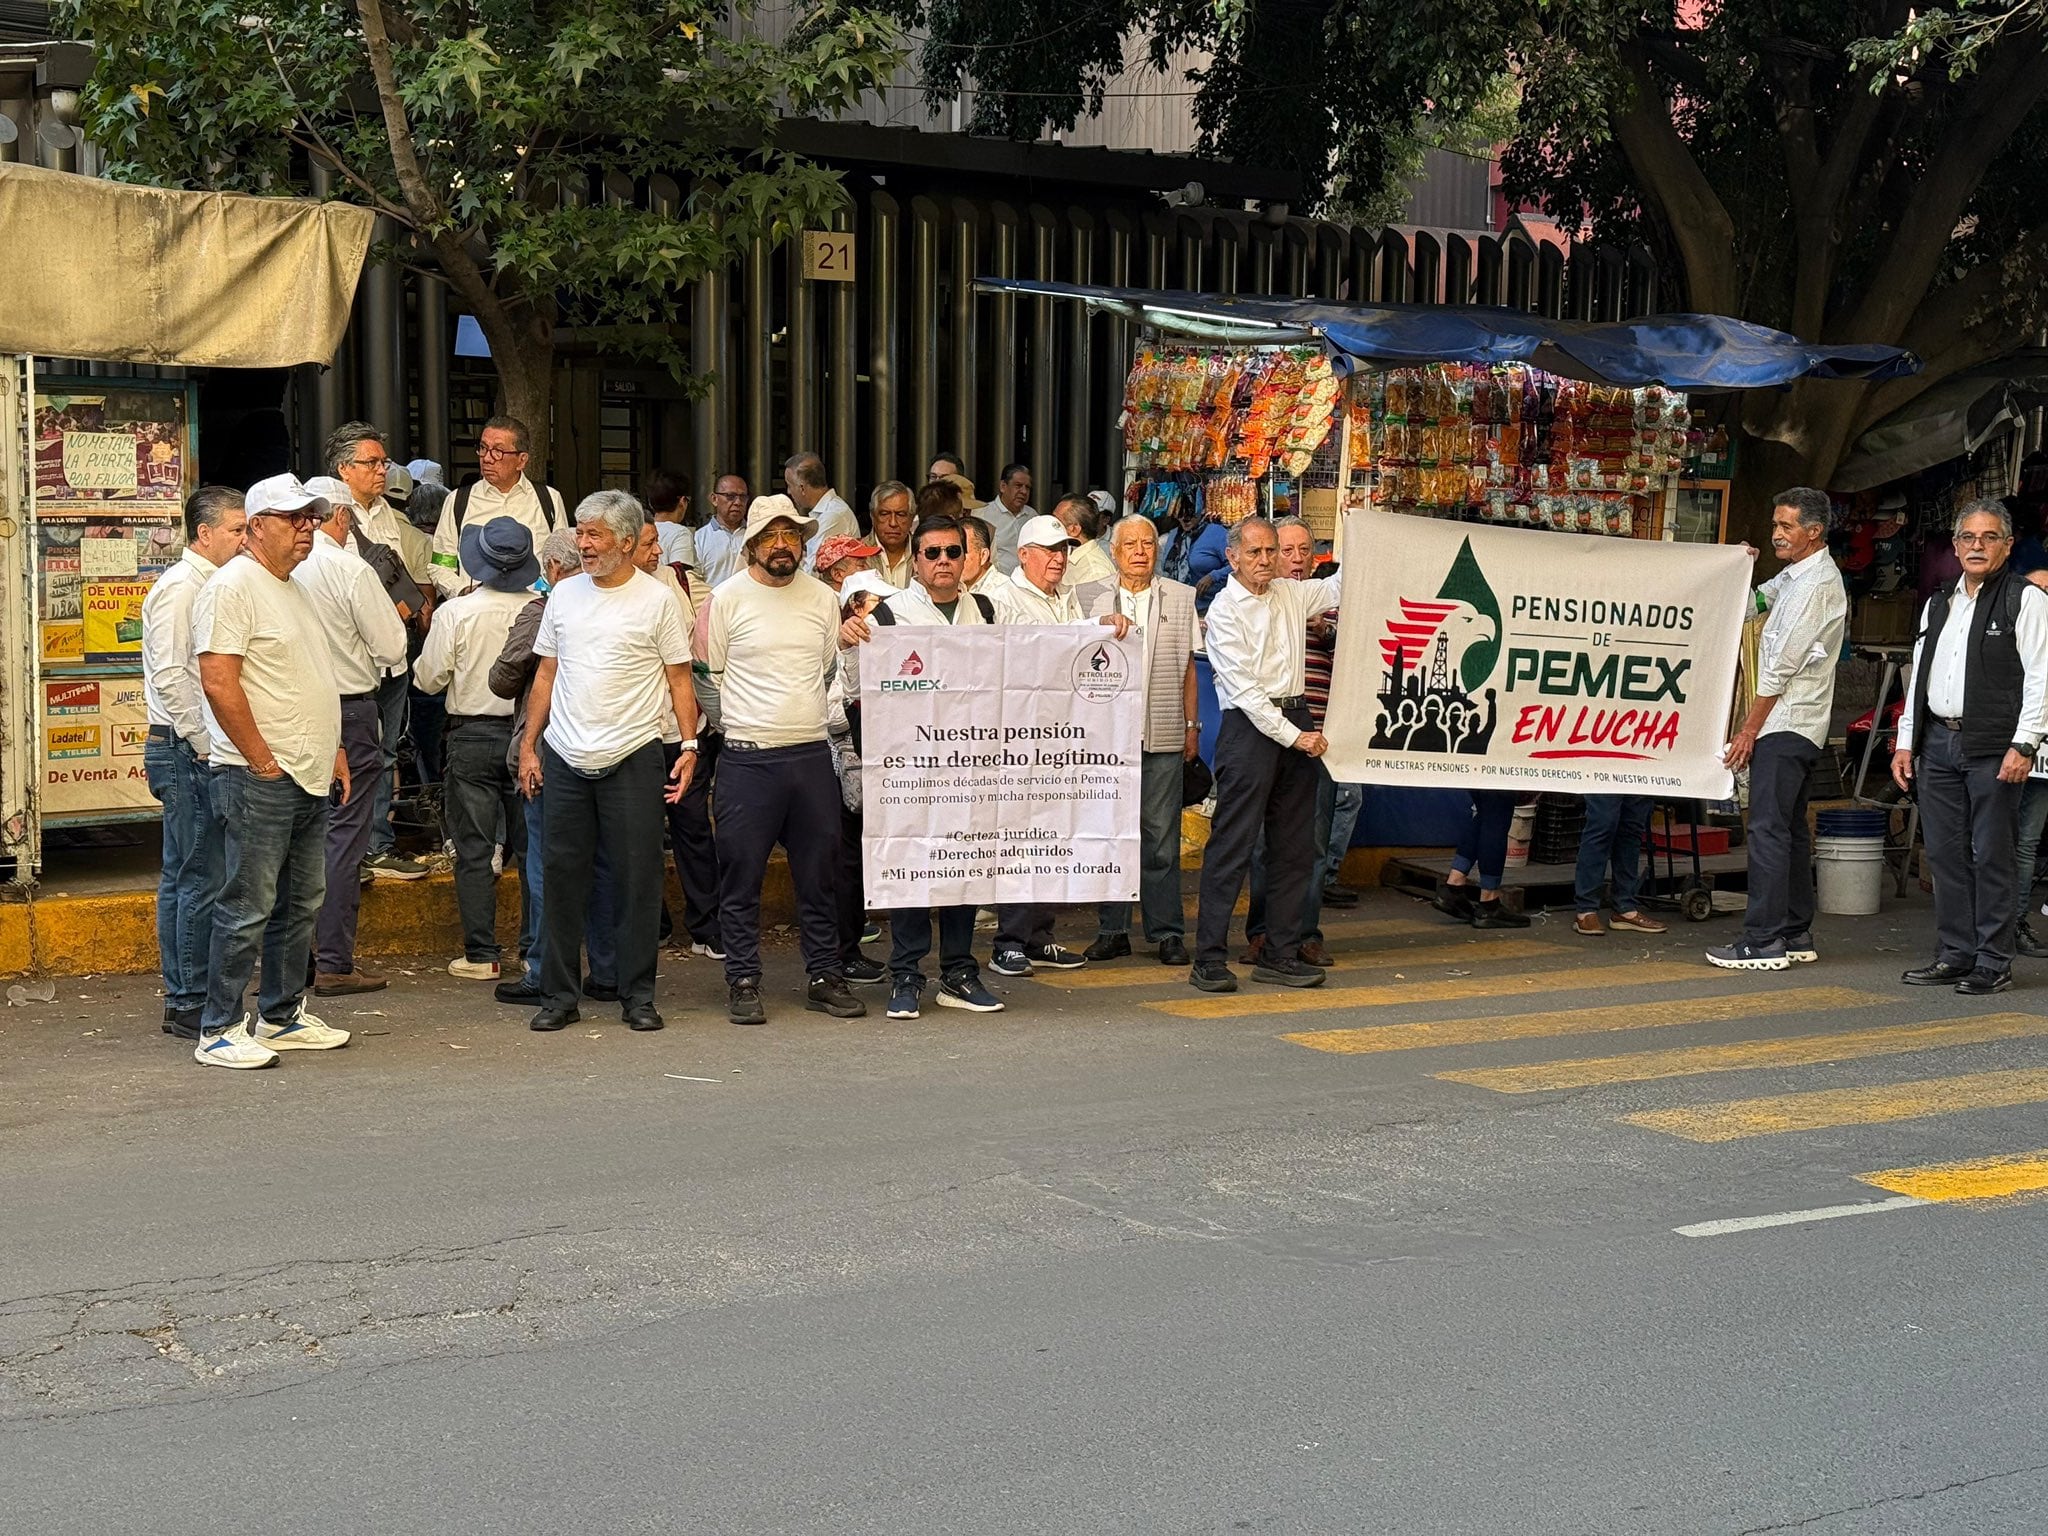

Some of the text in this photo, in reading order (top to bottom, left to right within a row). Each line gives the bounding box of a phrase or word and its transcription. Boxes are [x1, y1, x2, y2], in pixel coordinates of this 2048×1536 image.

[818, 243, 848, 270] 21
[65, 454, 80, 469] LA
[86, 453, 134, 469] PUERTA
[70, 472, 91, 486] POR
[93, 472, 136, 486] FAVOR
[88, 586, 149, 596] DE VENTA
[88, 600, 120, 610] AQUI
[1512, 595, 1694, 630] PENSIONADOS
[1593, 632, 1611, 647] DE
[1505, 648, 1692, 704] PEMEX
[881, 680, 940, 691] PEMEX
[65, 706, 98, 714] TELMEX
[915, 722, 1086, 743] Nuestra pensión
[1512, 704, 1680, 752] EN LUCHA
[52, 731, 86, 744] Ladatel
[66, 748, 98, 756] TELMEX
[883, 749, 1125, 769] es un derecho legítimo.
[48, 770, 69, 783] De
[72, 768, 118, 781] Venta
[1365, 759, 1682, 787] POR NUESTRAS PENSIONES POR NUESTROS DERECHOS POR NUESTRO FUTURO
[882, 774, 1120, 790] Cumplimos décadas de servicio en Pemex
[880, 789, 1122, 806] con compromiso y mucha responsabilidad.
[945, 828, 1058, 842] #Certeza jurídica
[929, 845, 1073, 860] #Derechos adquiridos
[881, 867, 906, 879] #Mi
[910, 867, 965, 881] pensión
[969, 867, 983, 877] es
[1035, 865, 1051, 874] no
[1055, 865, 1069, 874] es
[1073, 862, 1121, 874] dorada
